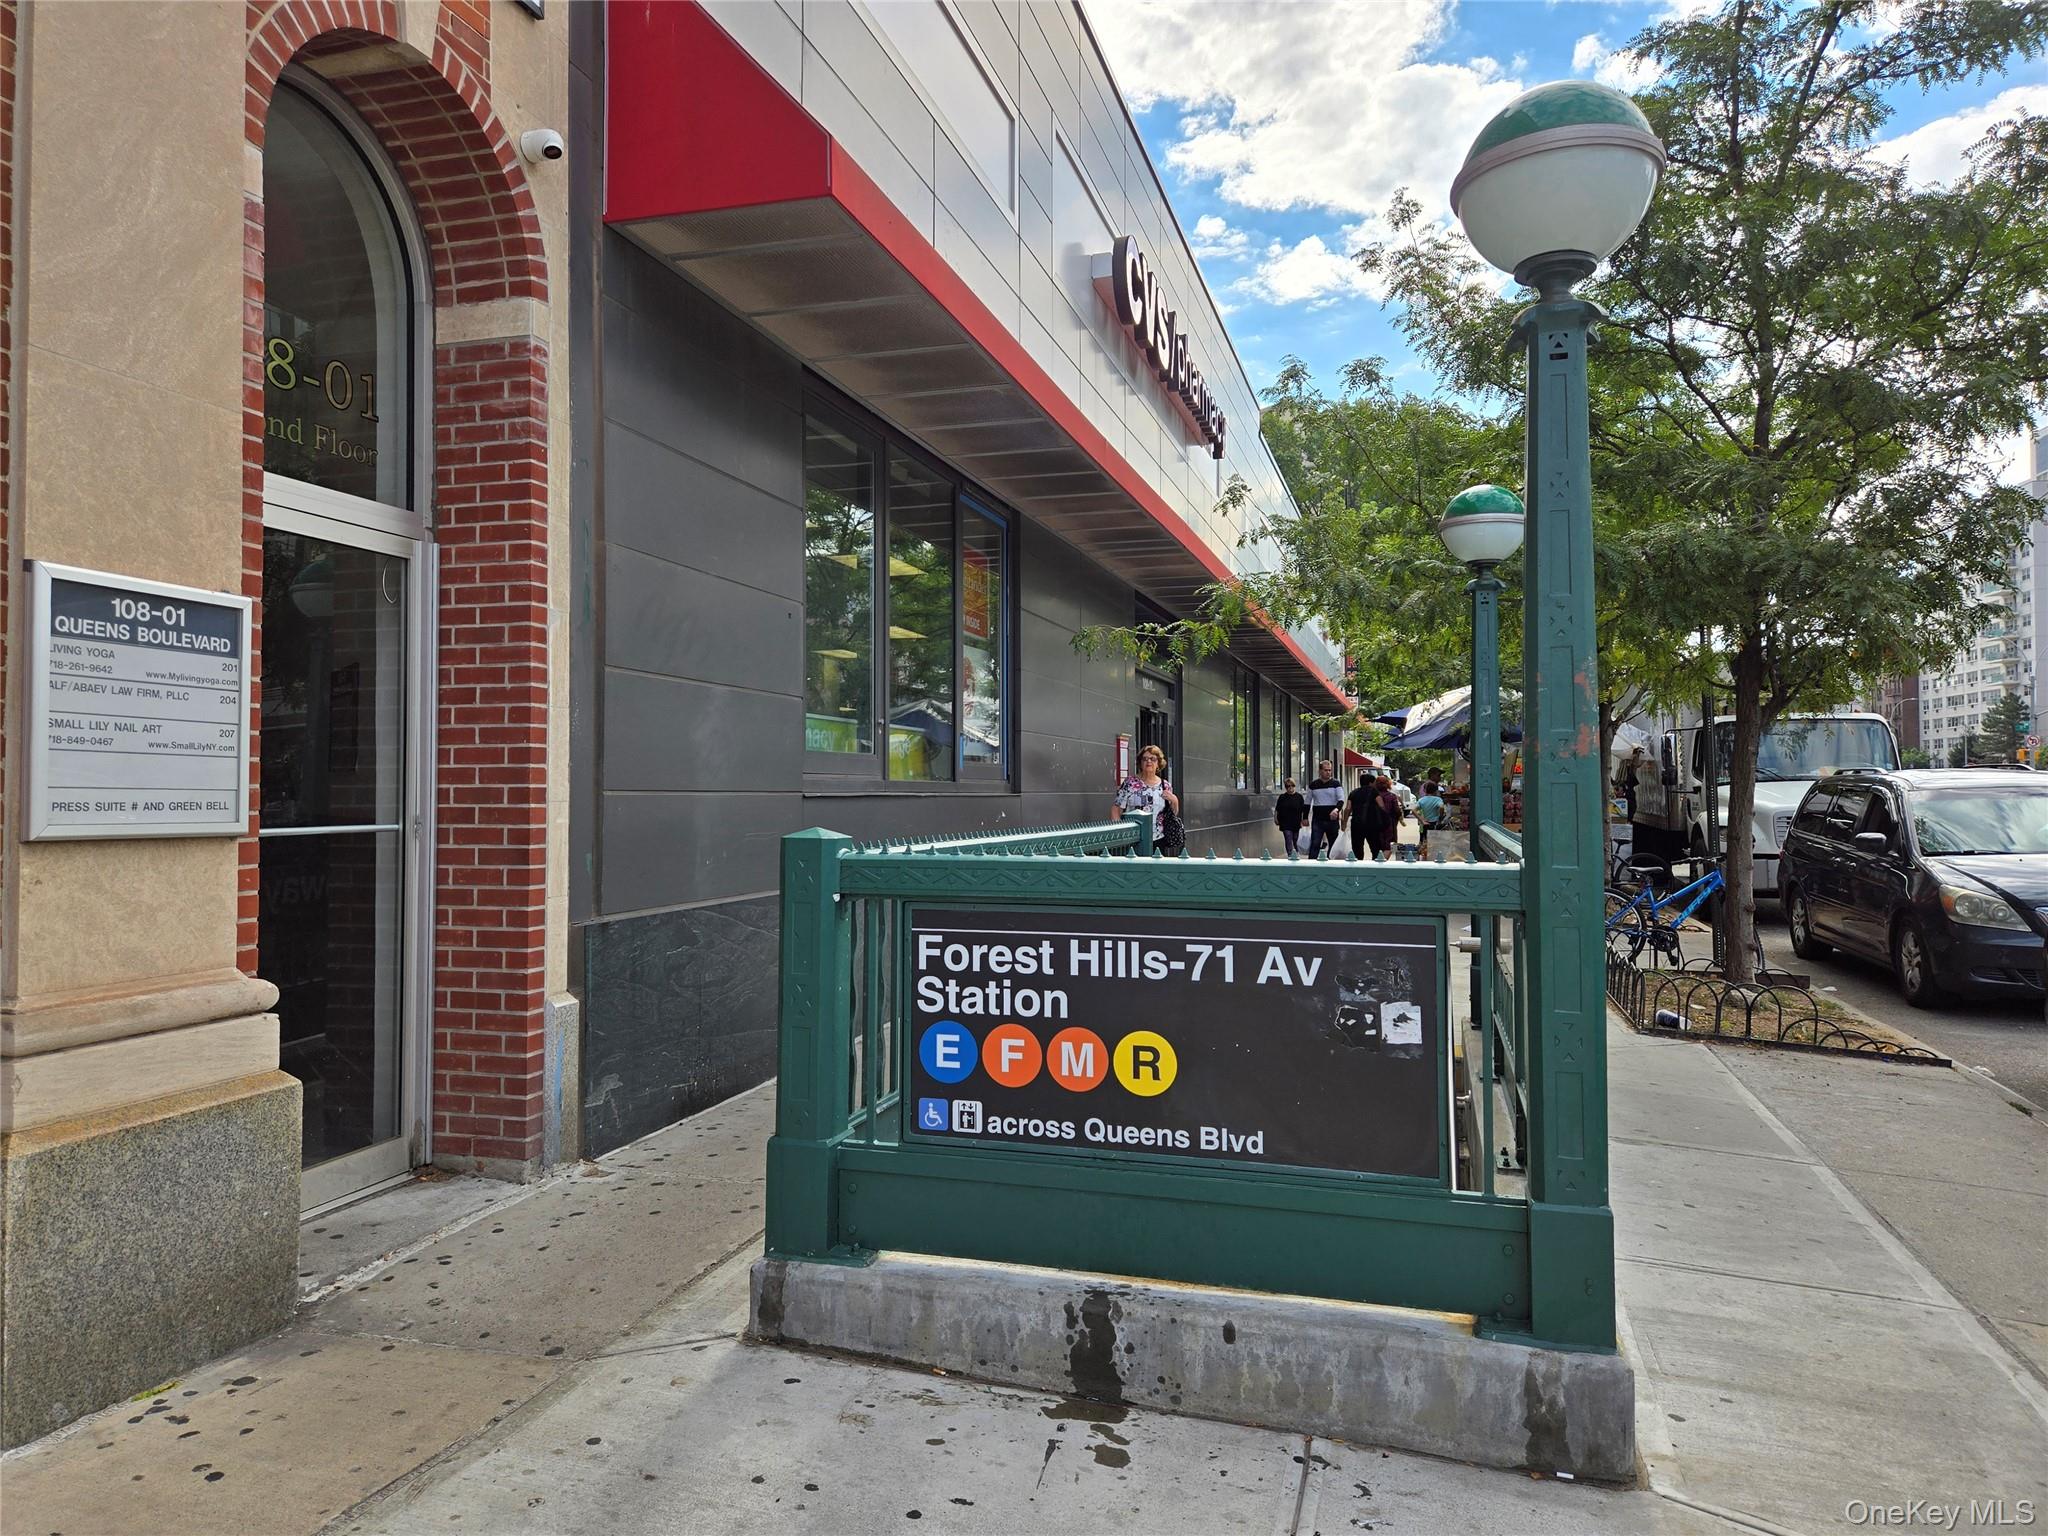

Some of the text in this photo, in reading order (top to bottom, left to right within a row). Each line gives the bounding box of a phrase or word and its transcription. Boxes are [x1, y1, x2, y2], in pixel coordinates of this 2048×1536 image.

[314, 423, 379, 467] Floor
[111, 598, 186, 628] 108-01
[55, 615, 231, 653] QUEENS BOULEVARD
[86, 647, 116, 659] YOGA
[222, 663, 238, 673] 201
[145, 671, 238, 686] www.Mylivingyoga.com
[111, 685, 133, 697] LAW
[166, 690, 190, 701] PLLC
[219, 695, 237, 705] 204
[48, 717, 163, 734] SMALL LILY NAIL ART
[219, 729, 235, 738] 207
[48, 734, 114, 746] 18-849-0467
[51, 801, 229, 812] PRESS SUITE # AND GREEN BELL
[918, 934, 1322, 986] Forest Hills-71 Av
[917, 975, 1068, 1019] Station
[936, 1034, 1161, 1081] E F M R
[987, 1116, 1264, 1154] across Queens Blvd
